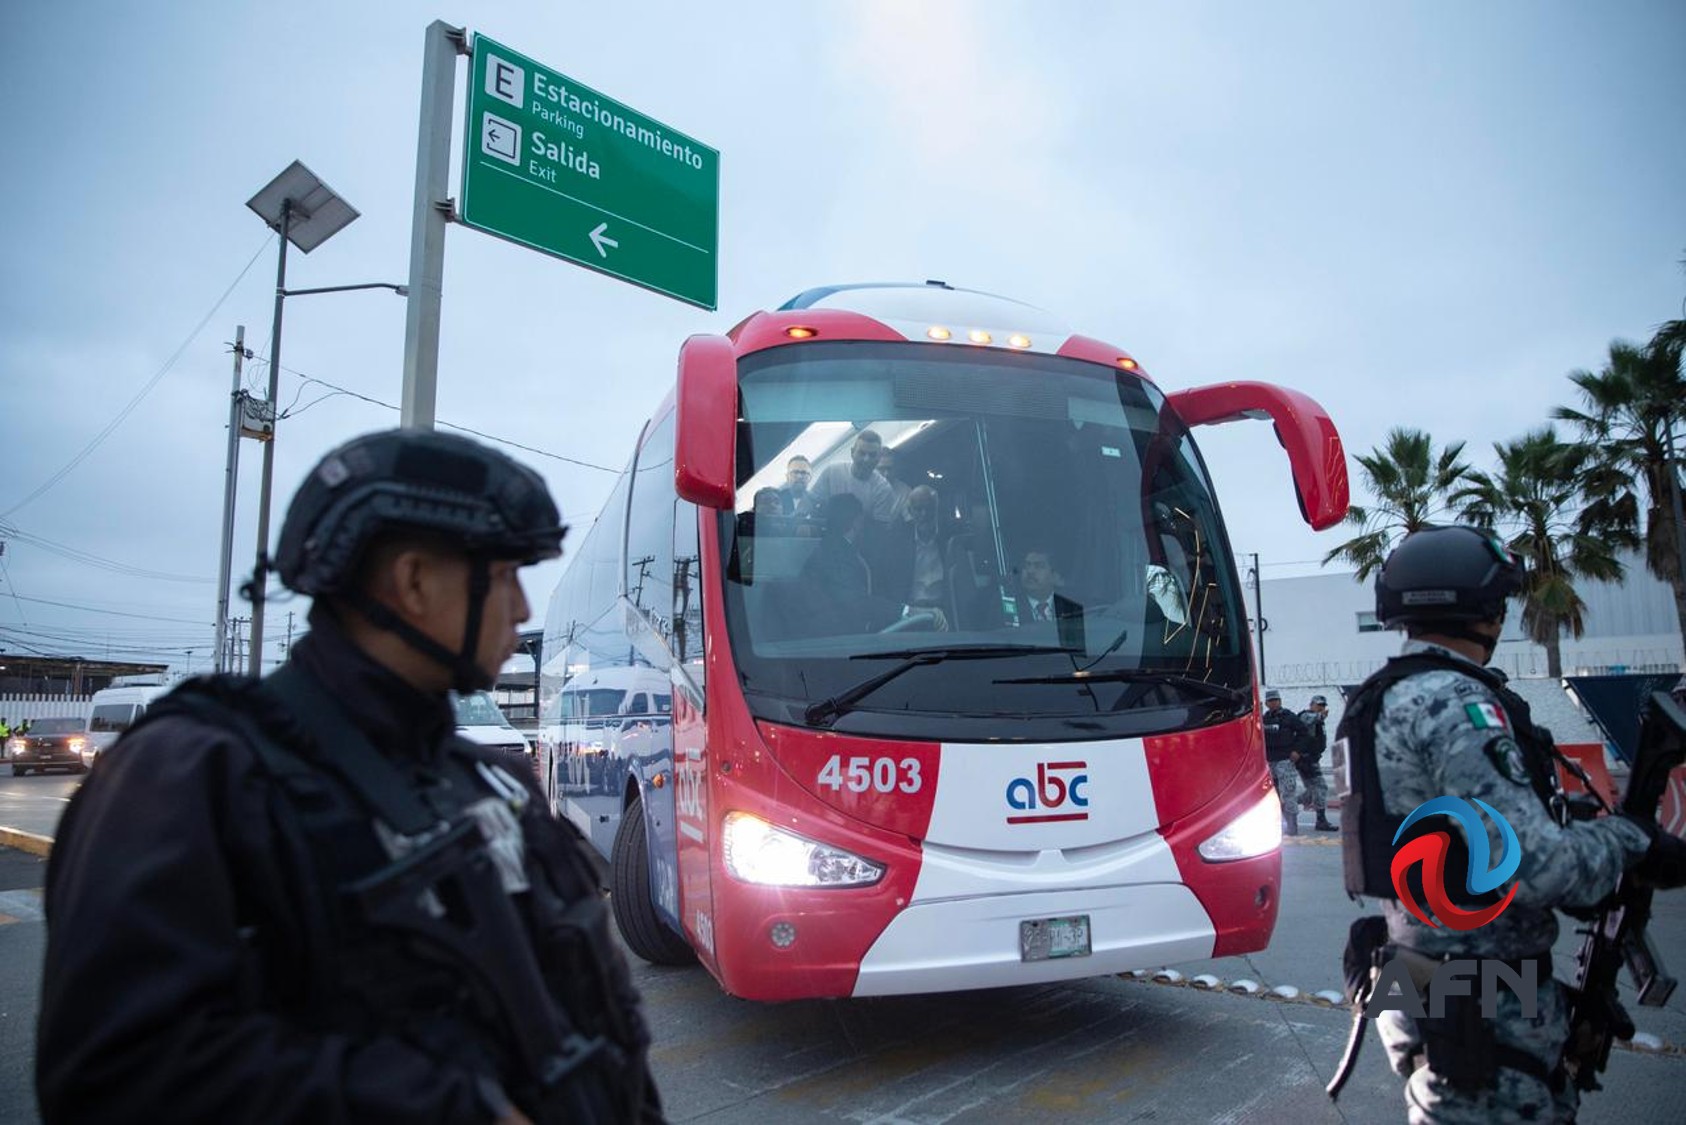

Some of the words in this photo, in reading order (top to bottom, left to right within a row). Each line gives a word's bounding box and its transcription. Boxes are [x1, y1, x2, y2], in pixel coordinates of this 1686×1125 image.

[495, 63, 514, 99] E
[532, 101, 584, 139] Parking
[533, 72, 702, 170] Estacionamiento
[529, 160, 557, 183] Exit
[531, 131, 600, 180] Salida
[817, 755, 922, 794] 4503
[1006, 761, 1089, 810] abc
